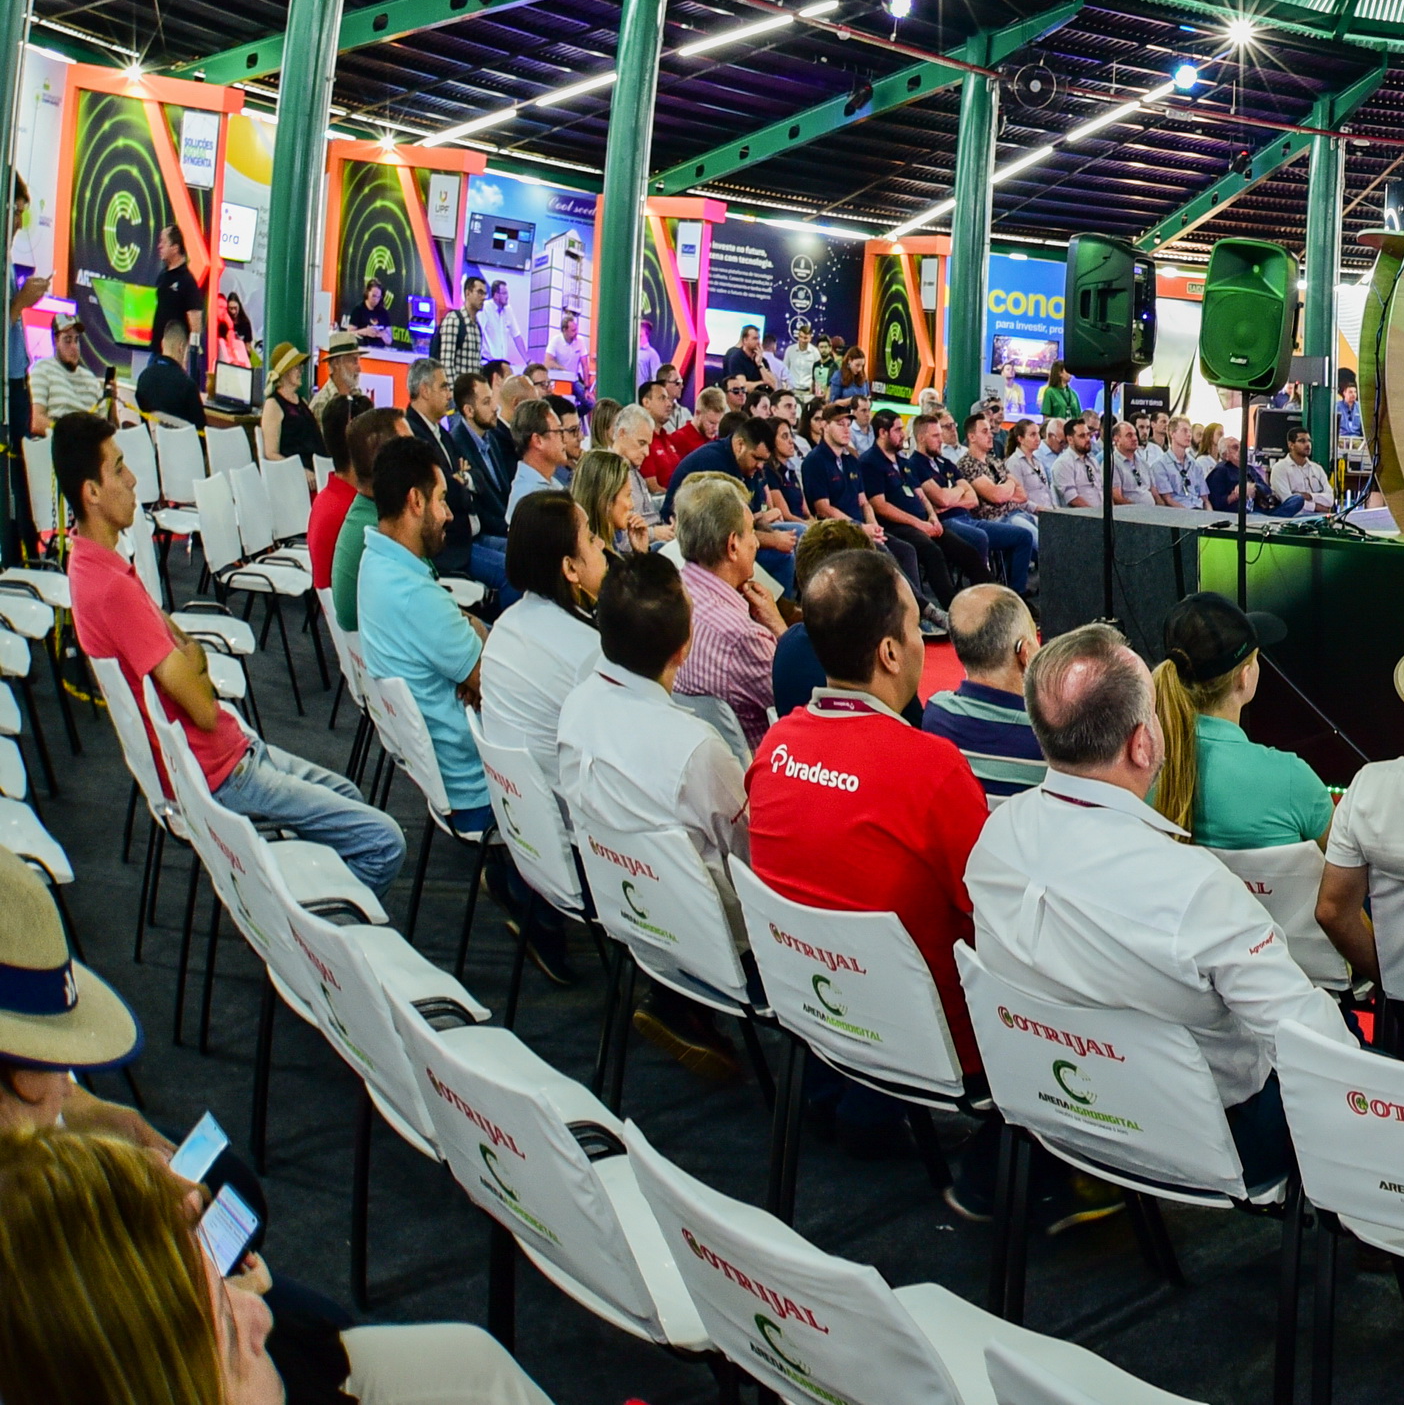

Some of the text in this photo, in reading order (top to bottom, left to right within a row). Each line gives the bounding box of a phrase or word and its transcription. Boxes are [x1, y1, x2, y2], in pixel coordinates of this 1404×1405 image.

[996, 320, 1014, 330] para
[1016, 320, 1048, 334] investir,
[784, 755, 860, 792] bradesco
[588, 834, 660, 881] COTRIJAL
[769, 922, 867, 976] COTRIJAL
[997, 1005, 1126, 1063] COTRIJAL
[681, 1227, 829, 1335] COTRIJAL
